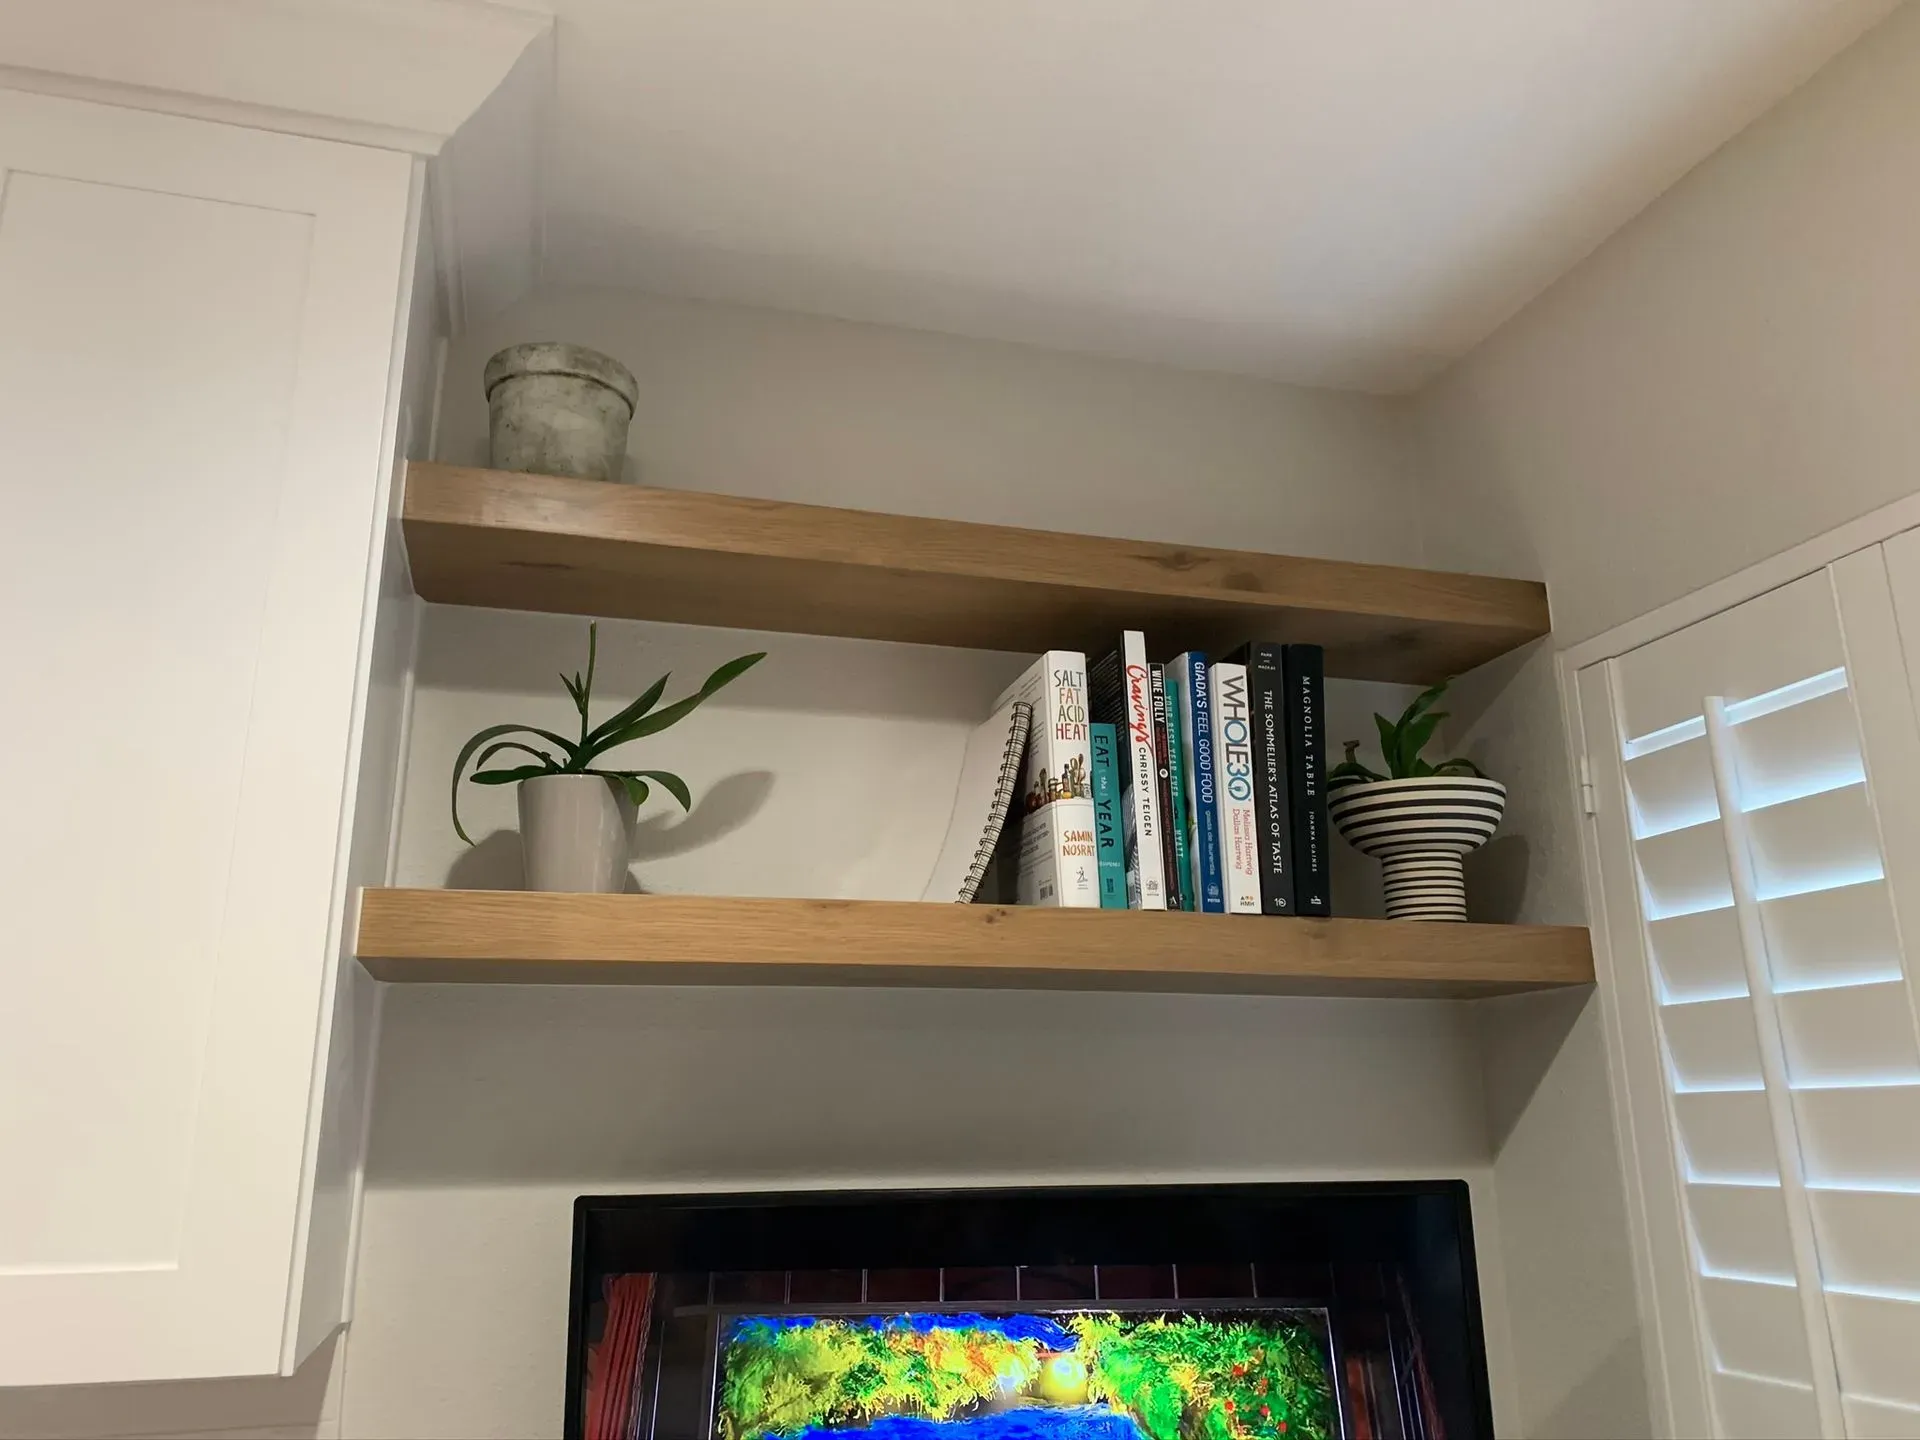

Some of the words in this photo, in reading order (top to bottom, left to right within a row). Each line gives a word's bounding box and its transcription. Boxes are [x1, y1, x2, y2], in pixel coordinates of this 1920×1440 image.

[1053, 669, 1084, 688] SALT
[1151, 669, 1163, 697] WINE
[1194, 661, 1207, 709] GIADA'S
[1059, 687, 1082, 704] FAT
[1126, 664, 1152, 748] Cravings
[1154, 696, 1166, 724] FOLLY
[1263, 690, 1273, 710] THE
[1302, 675, 1313, 747] MAGNOLIA
[1057, 705, 1085, 722] ACID
[1197, 710, 1208, 736] FEEL
[1055, 723, 1088, 741] HEAT
[1264, 713, 1277, 782] SOMMELIER'S
[1093, 735, 1110, 767] EAT
[1199, 738, 1212, 774] GOOD
[1138, 747, 1150, 793] CHRISSY
[1305, 754, 1315, 796] TABLE
[1200, 772, 1213, 804] FOOD
[1268, 784, 1279, 819] ATLAS
[1097, 799, 1115, 848] YEAR
[1142, 798, 1152, 837] TEIGEN
[1232, 808, 1241, 835] Dallas
[1242, 809, 1252, 841] Melissa
[1270, 822, 1280, 839] OF
[1308, 811, 1316, 841] JOANNA
[1062, 844, 1095, 857] NOSRAT
[1063, 829, 1093, 842] SAMIN
[1174, 829, 1184, 859] HYATT
[1234, 836, 1243, 870] Hartwig
[1244, 841, 1254, 875] Hartwig
[1271, 841, 1283, 875] TASTE
[1310, 843, 1318, 872] GAINES
